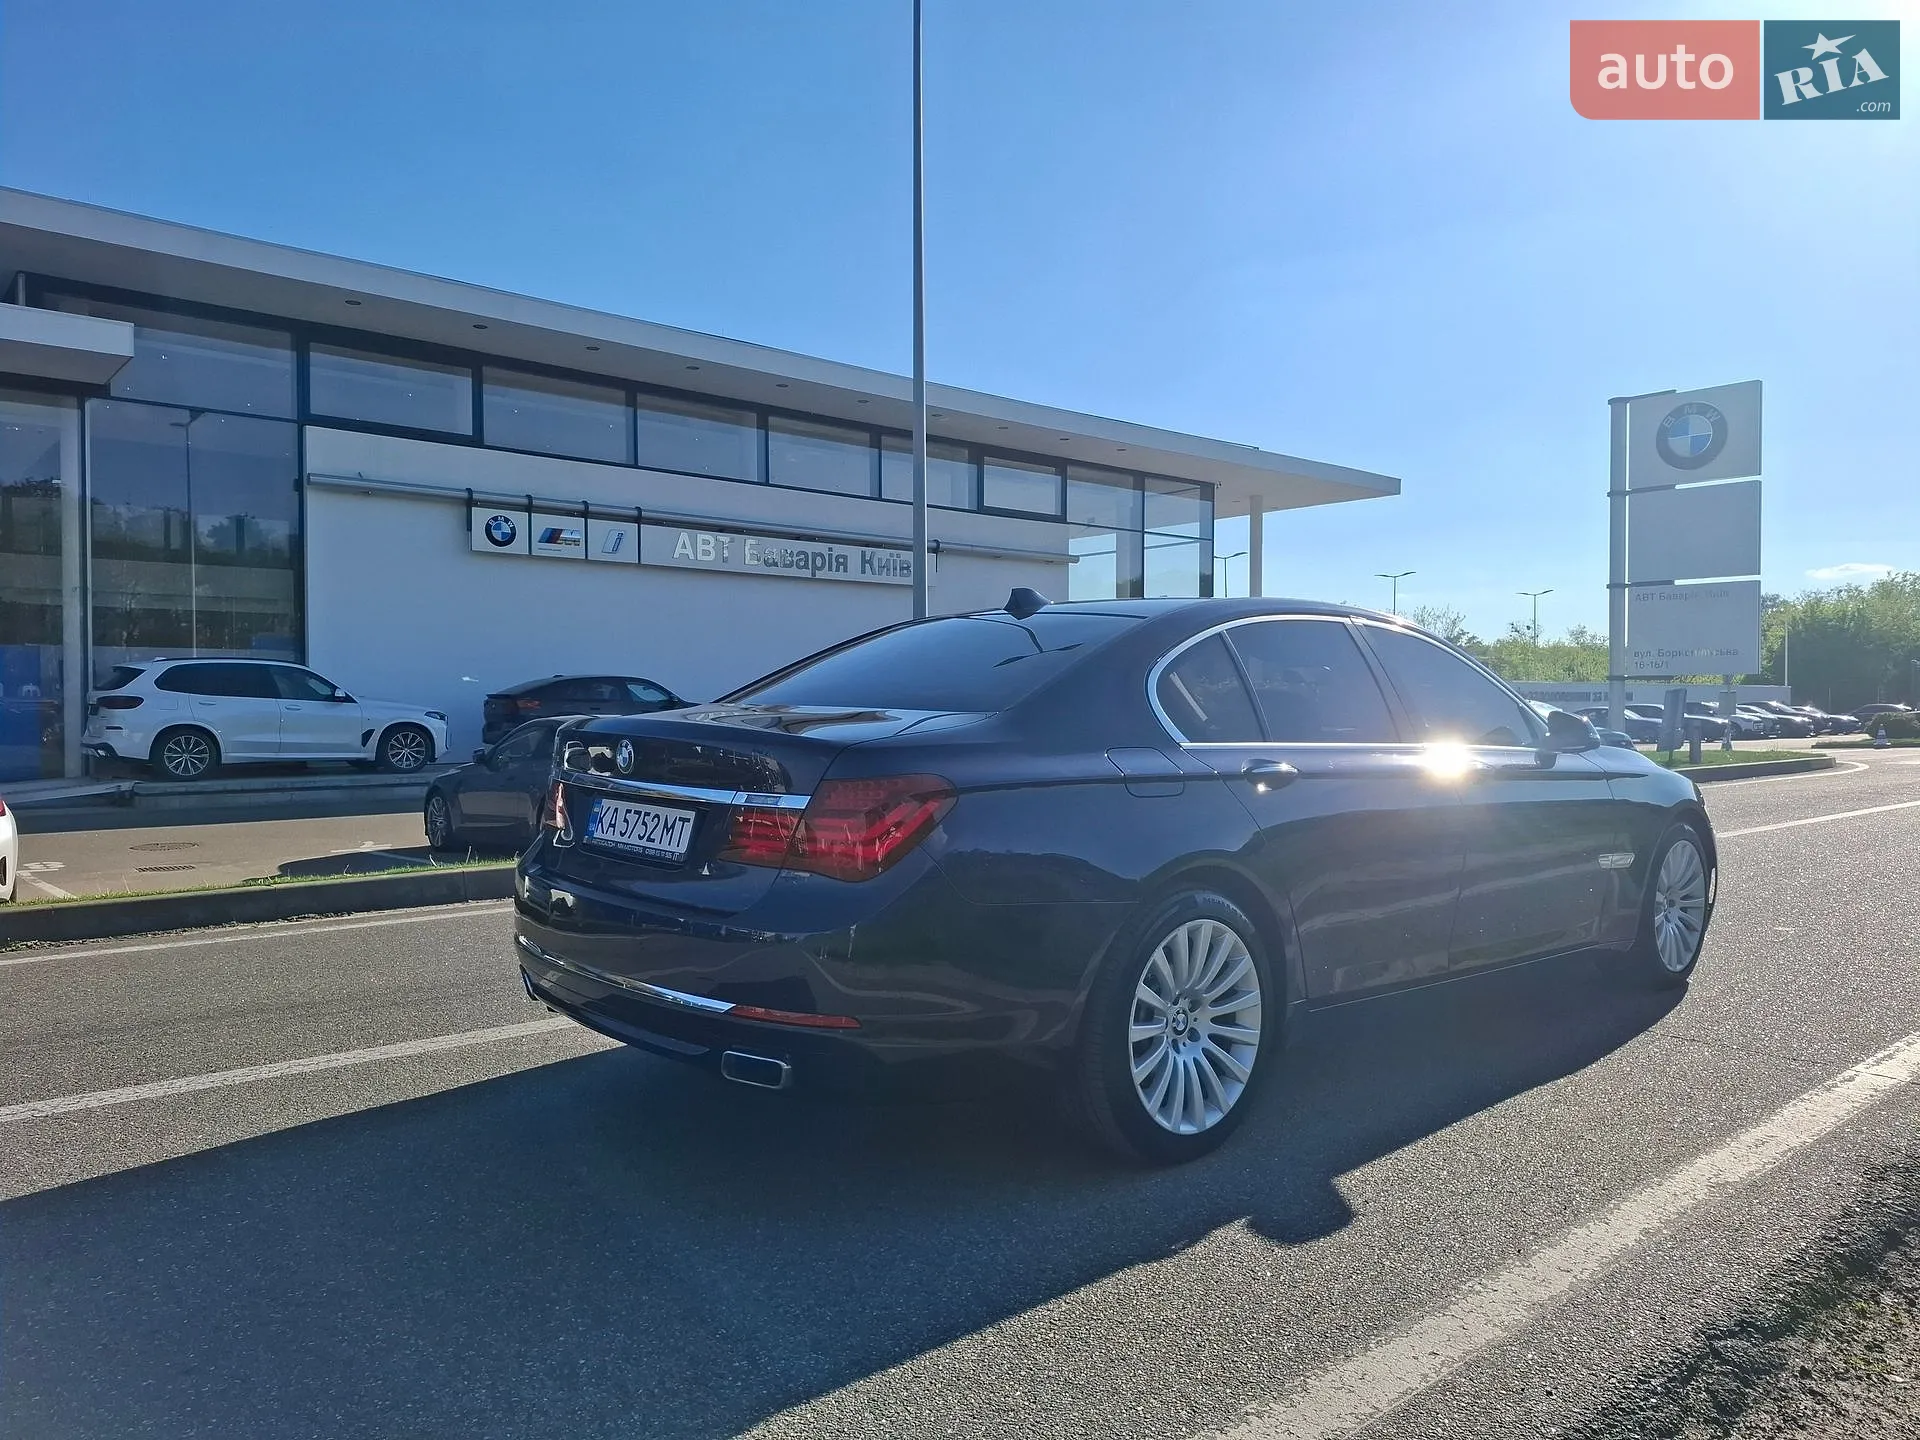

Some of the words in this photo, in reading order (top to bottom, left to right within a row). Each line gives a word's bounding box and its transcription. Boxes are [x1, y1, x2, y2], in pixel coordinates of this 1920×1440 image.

[672, 531, 735, 563] АВТ
[743, 538, 849, 577] Баварія
[860, 548, 913, 578] Київ
[1635, 592, 1657, 602] АВТ
[1659, 590, 1700, 602] Бавар
[1657, 647, 1739, 660] Борисська
